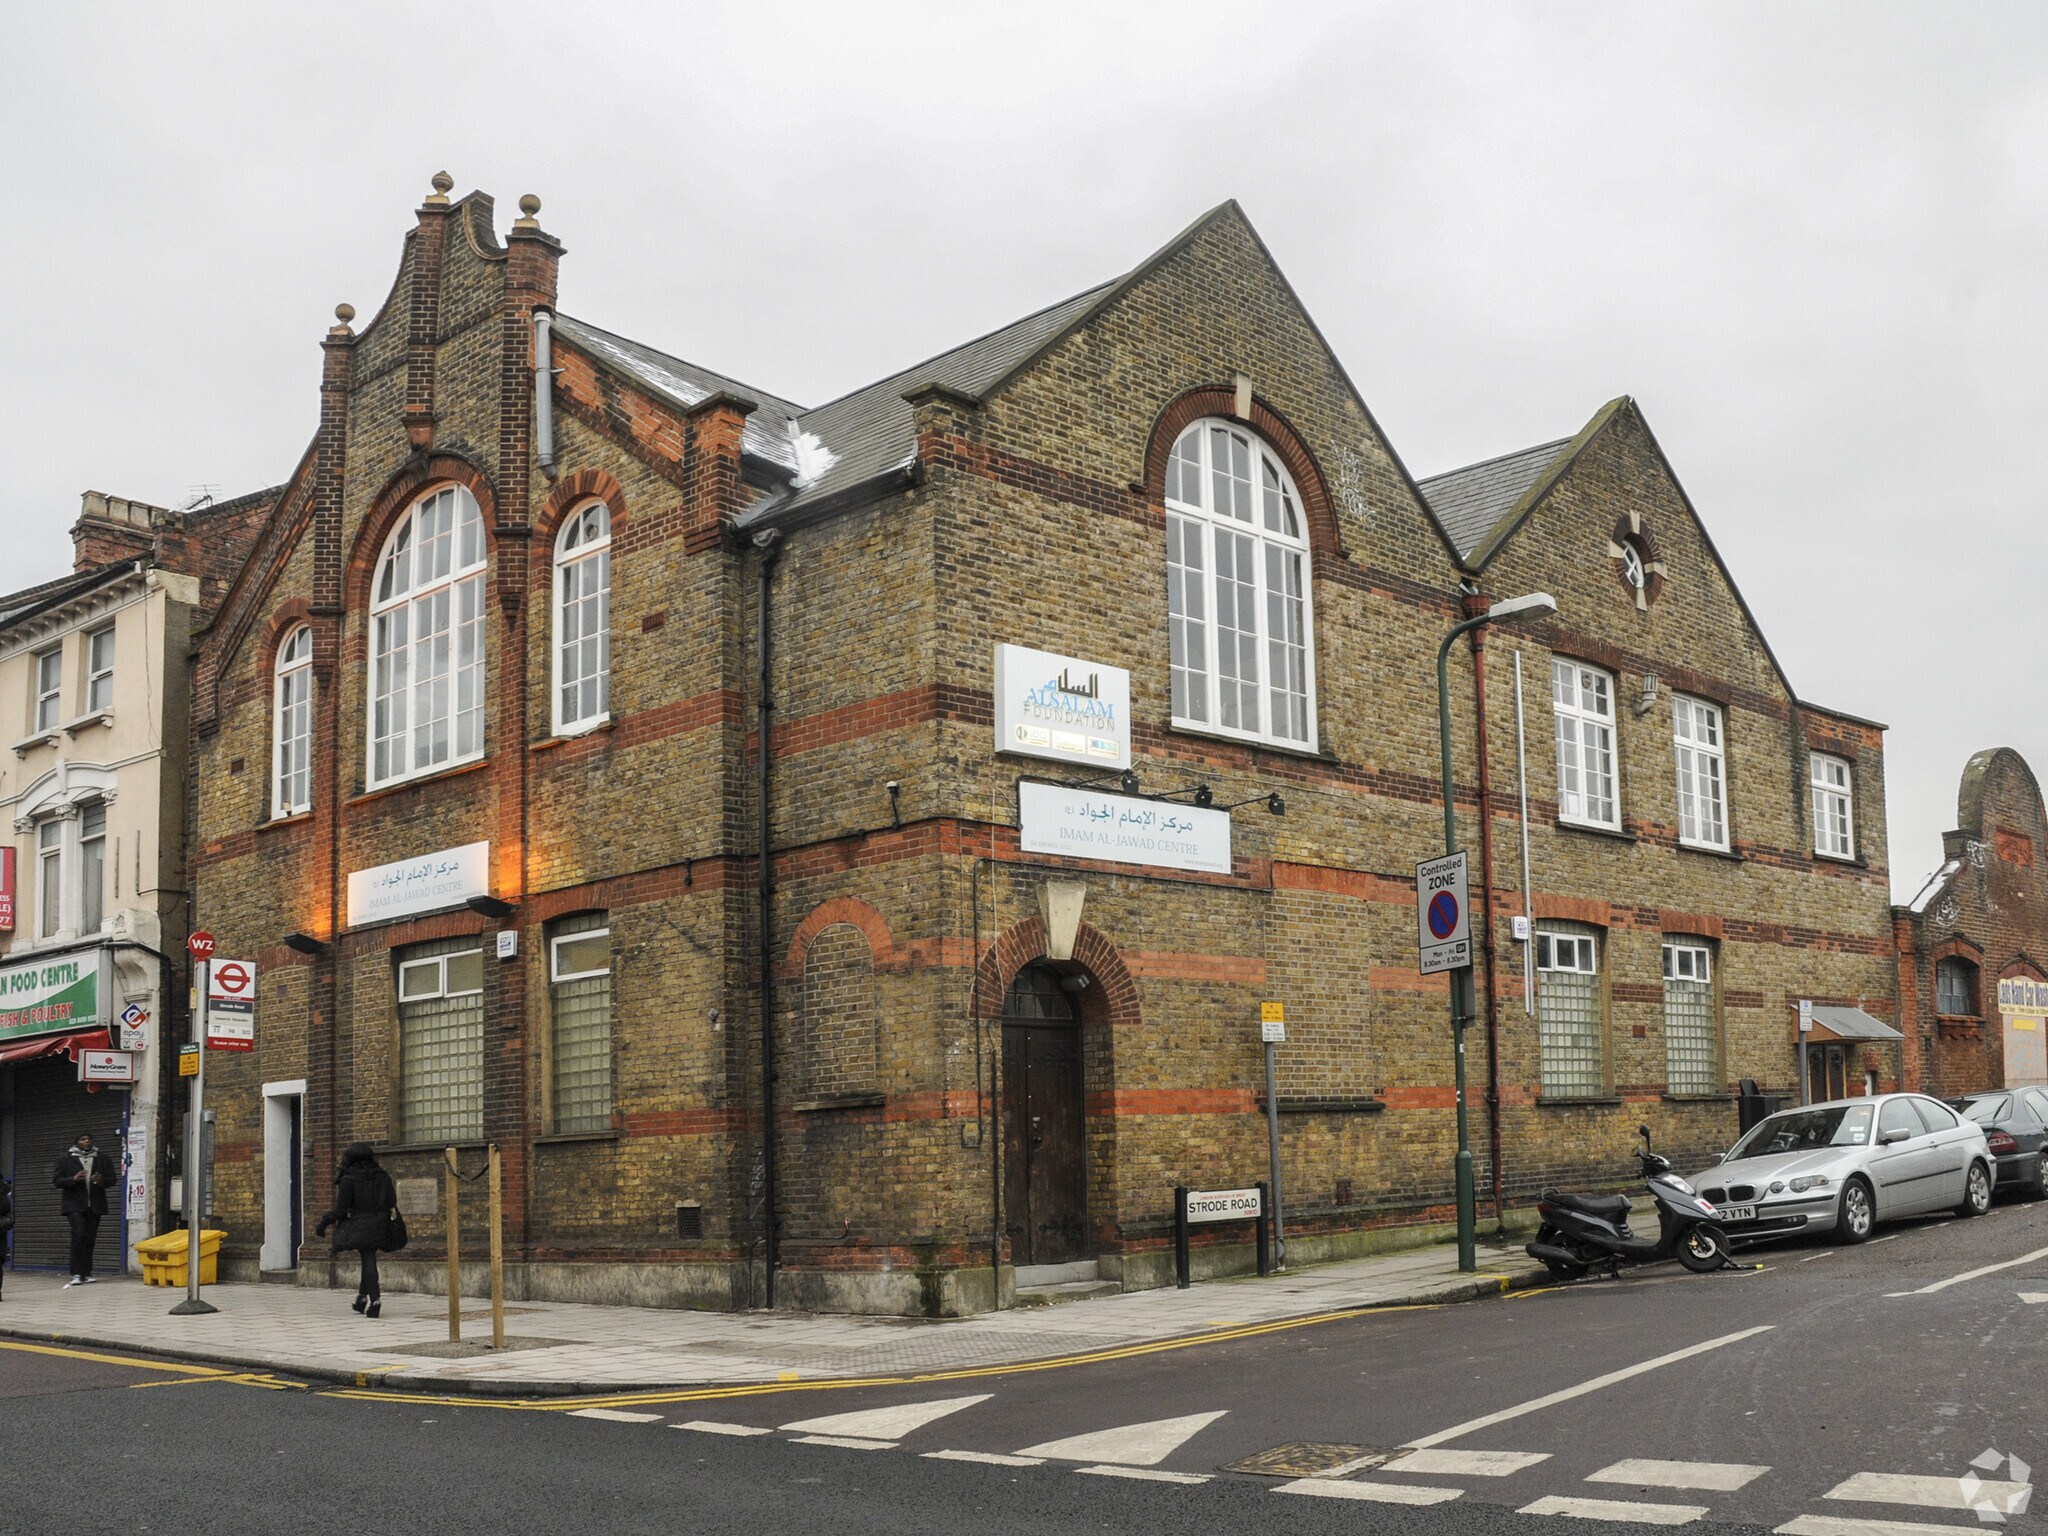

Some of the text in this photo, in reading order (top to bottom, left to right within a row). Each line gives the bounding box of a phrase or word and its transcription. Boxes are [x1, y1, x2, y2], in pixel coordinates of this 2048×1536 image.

[1024, 687, 1114, 719] ALSALAM
[1023, 703, 1115, 732] FOUNDATION
[1079, 802, 1115, 823] الجواد
[1160, 816, 1193, 834] مركز
[1059, 827, 1200, 856] IMAM AL-JAWAD CENTRE
[434, 861, 459, 878] مركز
[1421, 857, 1462, 877] Controlled
[1429, 873, 1455, 890] ZONE
[369, 896, 391, 909] IMAM
[392, 887, 431, 904] AL-JAWAD
[432, 880, 463, 895] CENTRE
[192, 939, 214, 950] WZ
[10, 971, 38, 994] FOOD
[41, 961, 79, 988] CENTRE
[0, 1001, 74, 1030] FISH & POULTRY
[123, 1030, 144, 1038] epay
[1188, 1198, 1258, 1213] STRODE ROAD
[1730, 1207, 1751, 1218] VTN
